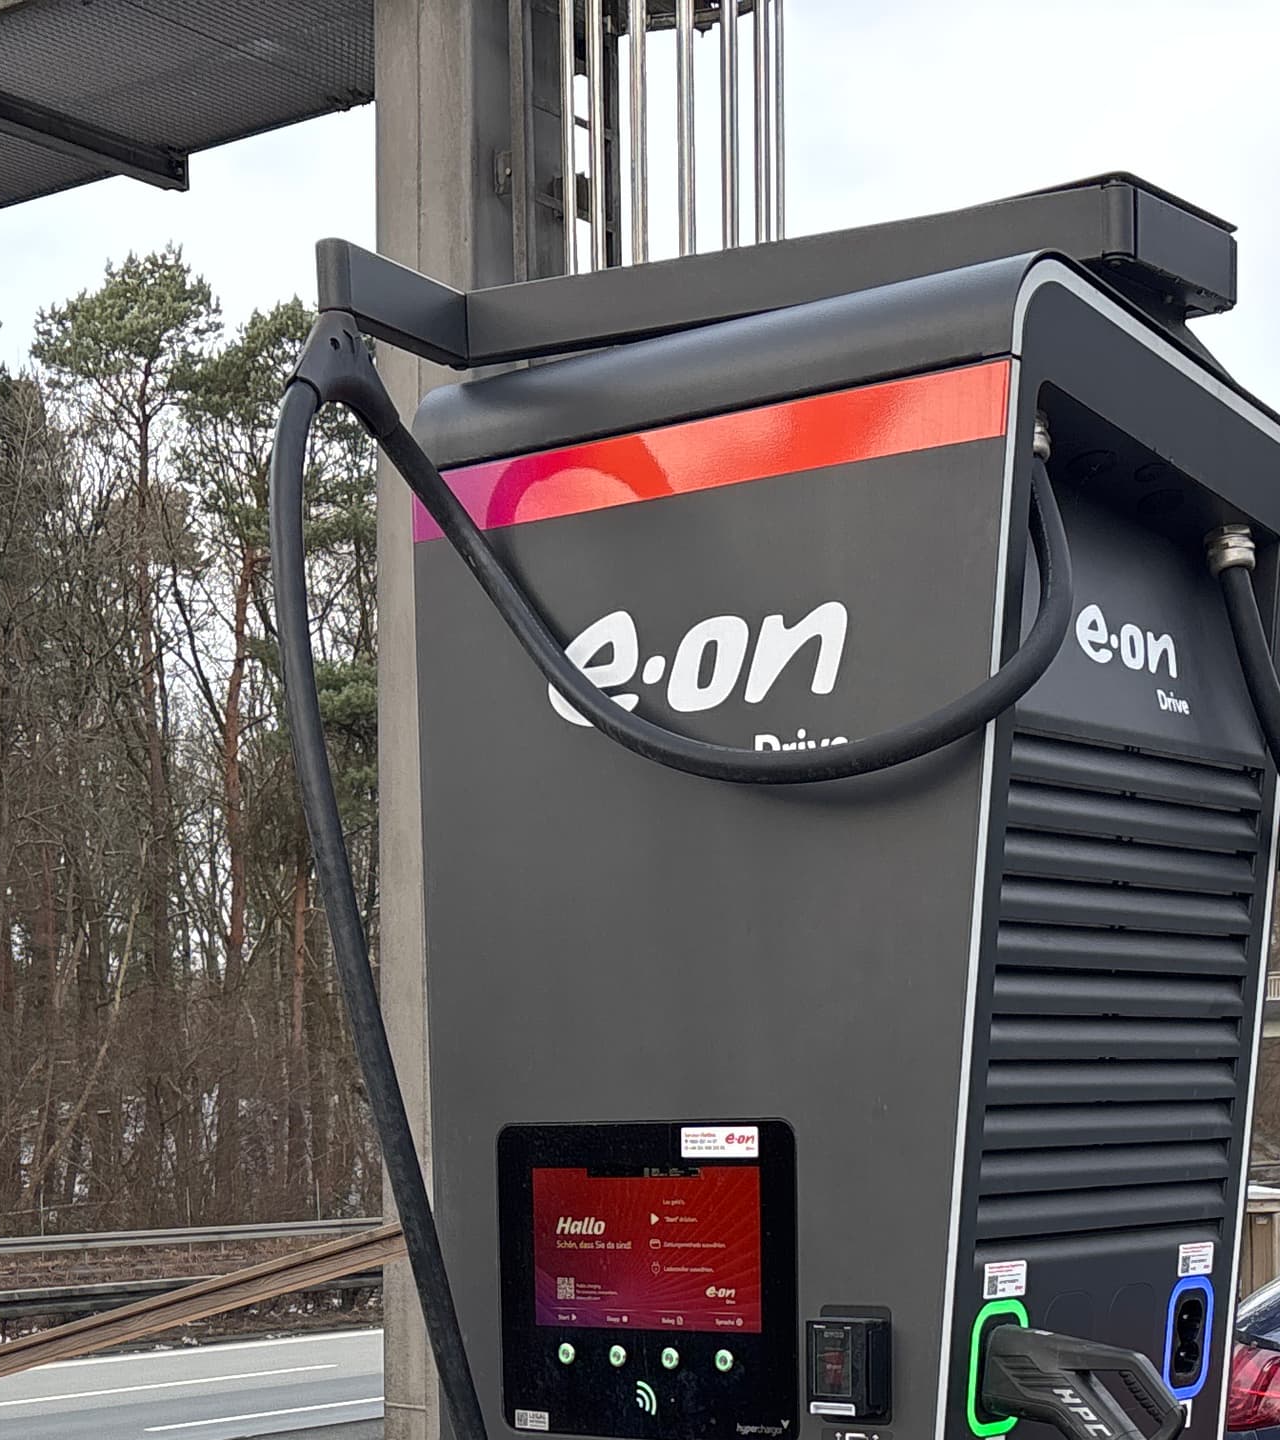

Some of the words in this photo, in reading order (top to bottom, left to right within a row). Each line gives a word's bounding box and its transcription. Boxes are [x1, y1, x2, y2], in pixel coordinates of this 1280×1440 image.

[1156, 689, 1190, 714] Drive
[556, 1216, 606, 1235] Hallo
[1052, 1389, 1112, 1437] HPC
